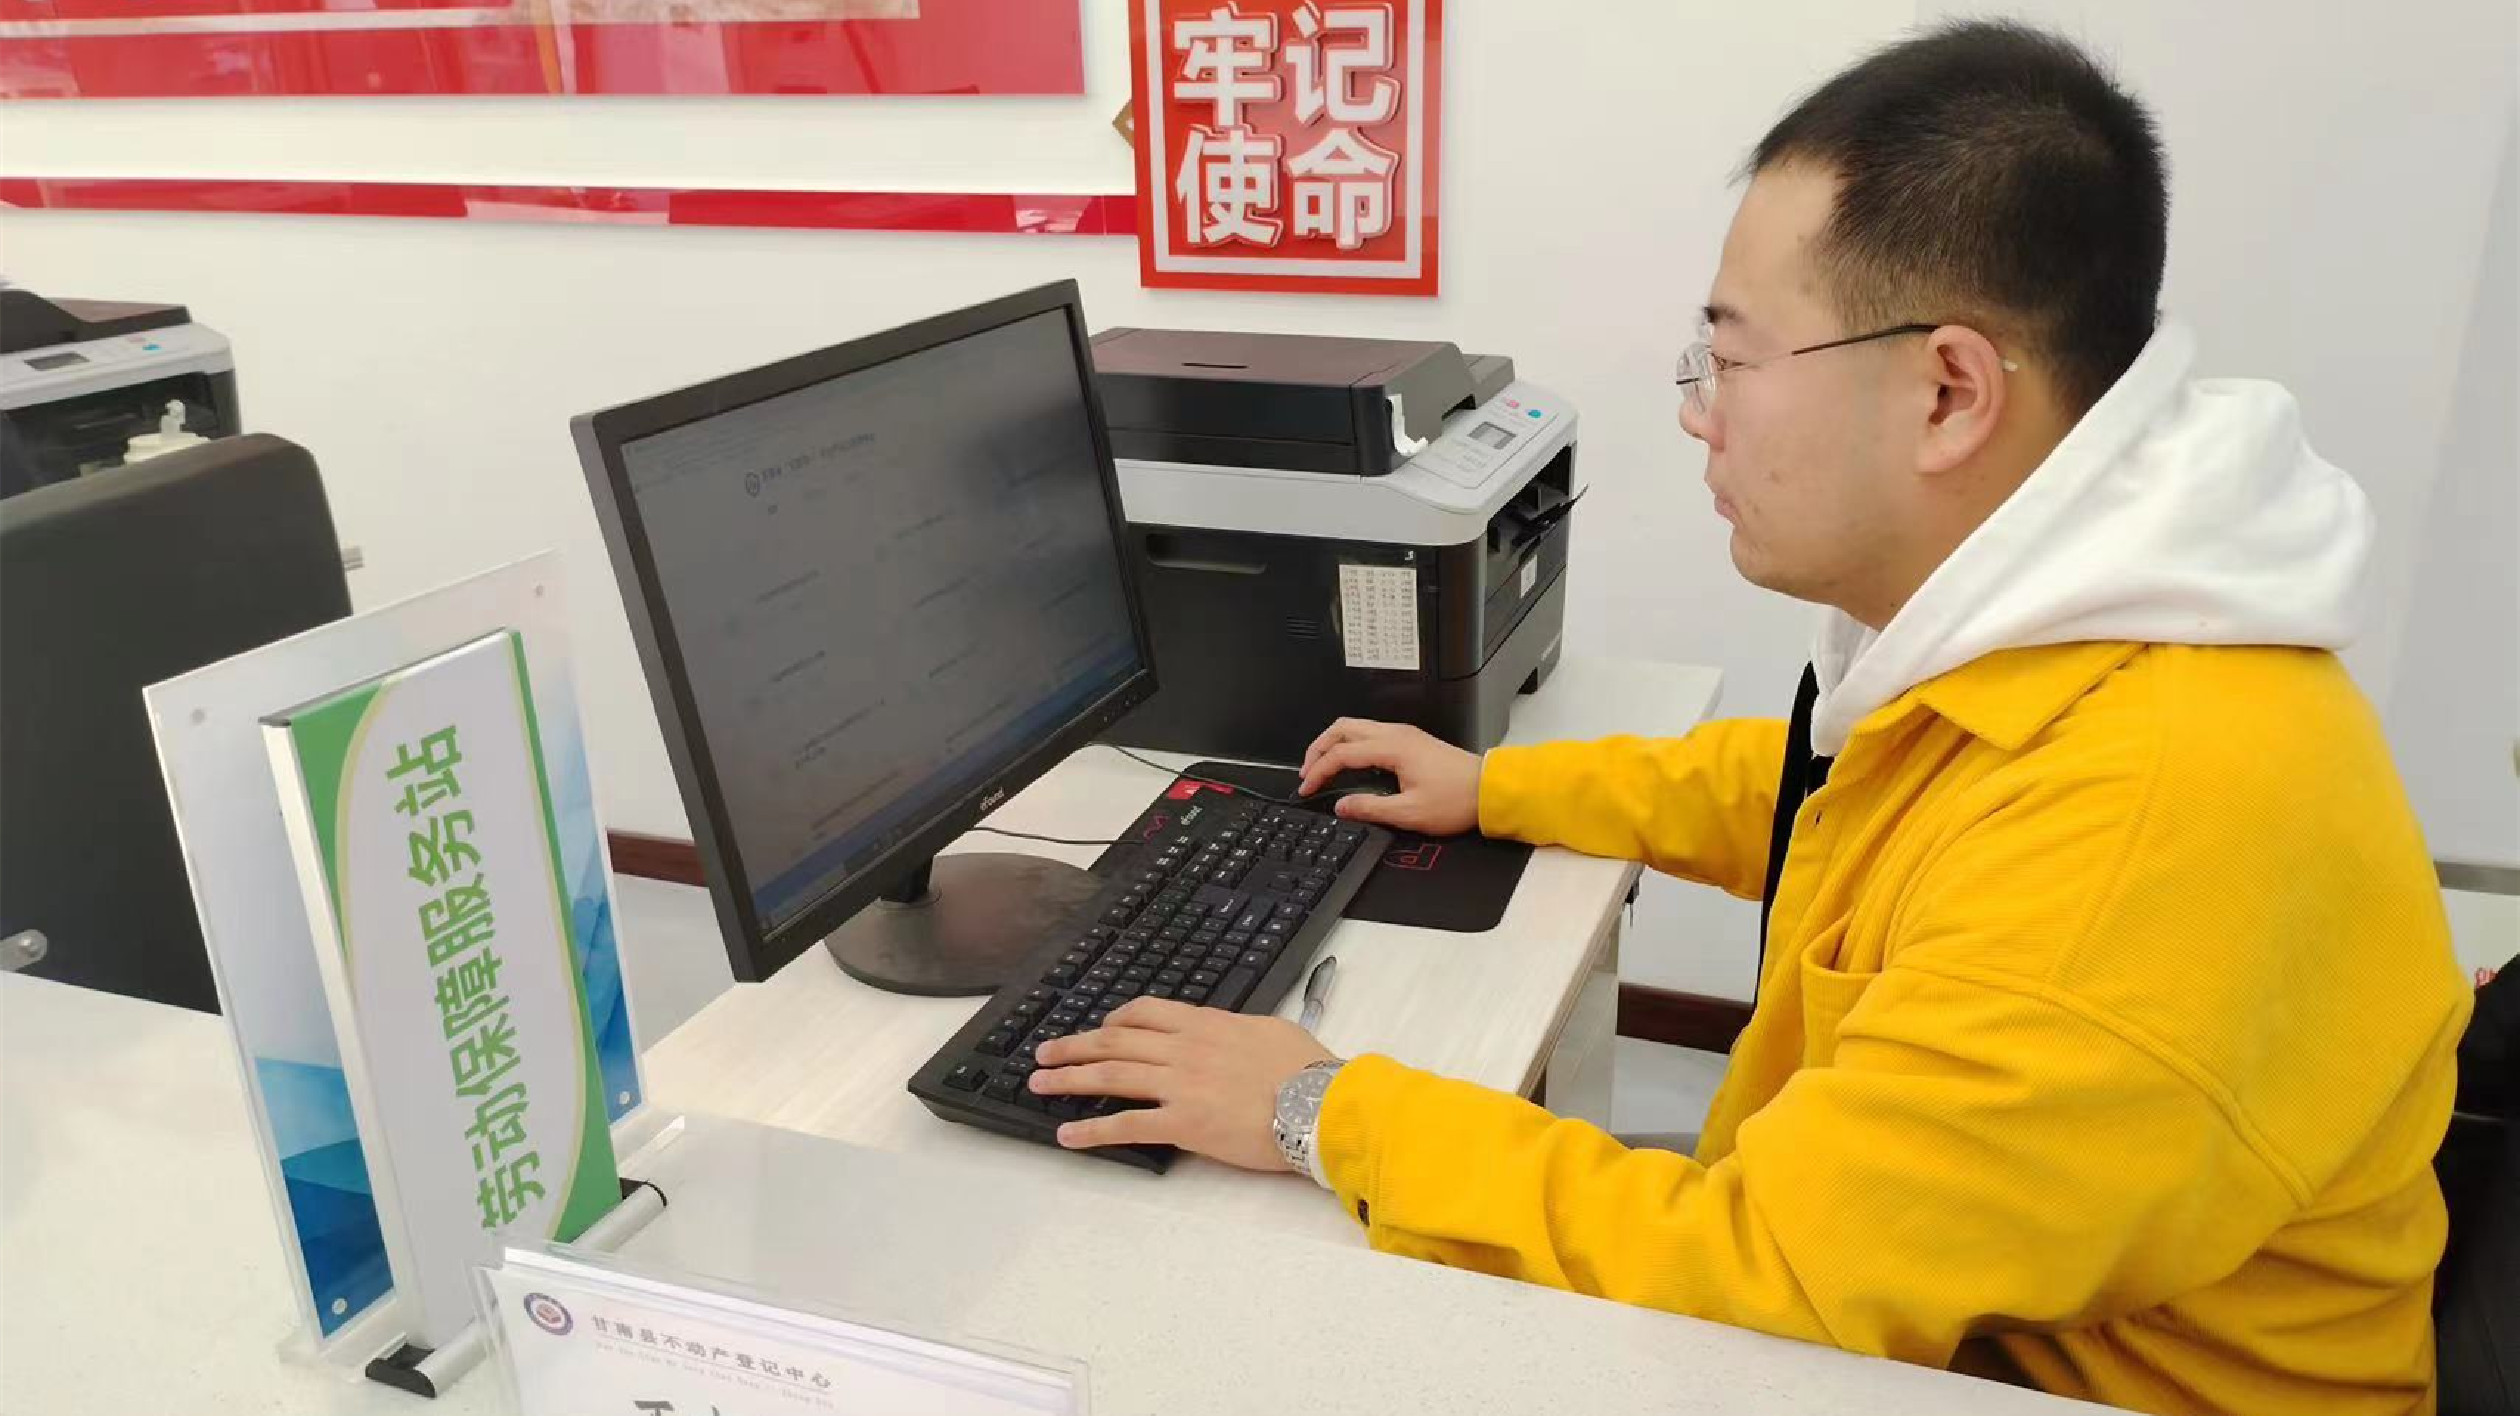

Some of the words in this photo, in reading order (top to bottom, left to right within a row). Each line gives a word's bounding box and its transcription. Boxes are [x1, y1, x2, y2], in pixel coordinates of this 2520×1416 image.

[1173, 4, 1397, 126] 牢记
[1176, 126, 1397, 249] 使命
[385, 725, 547, 1231] 劳动保障服务站
